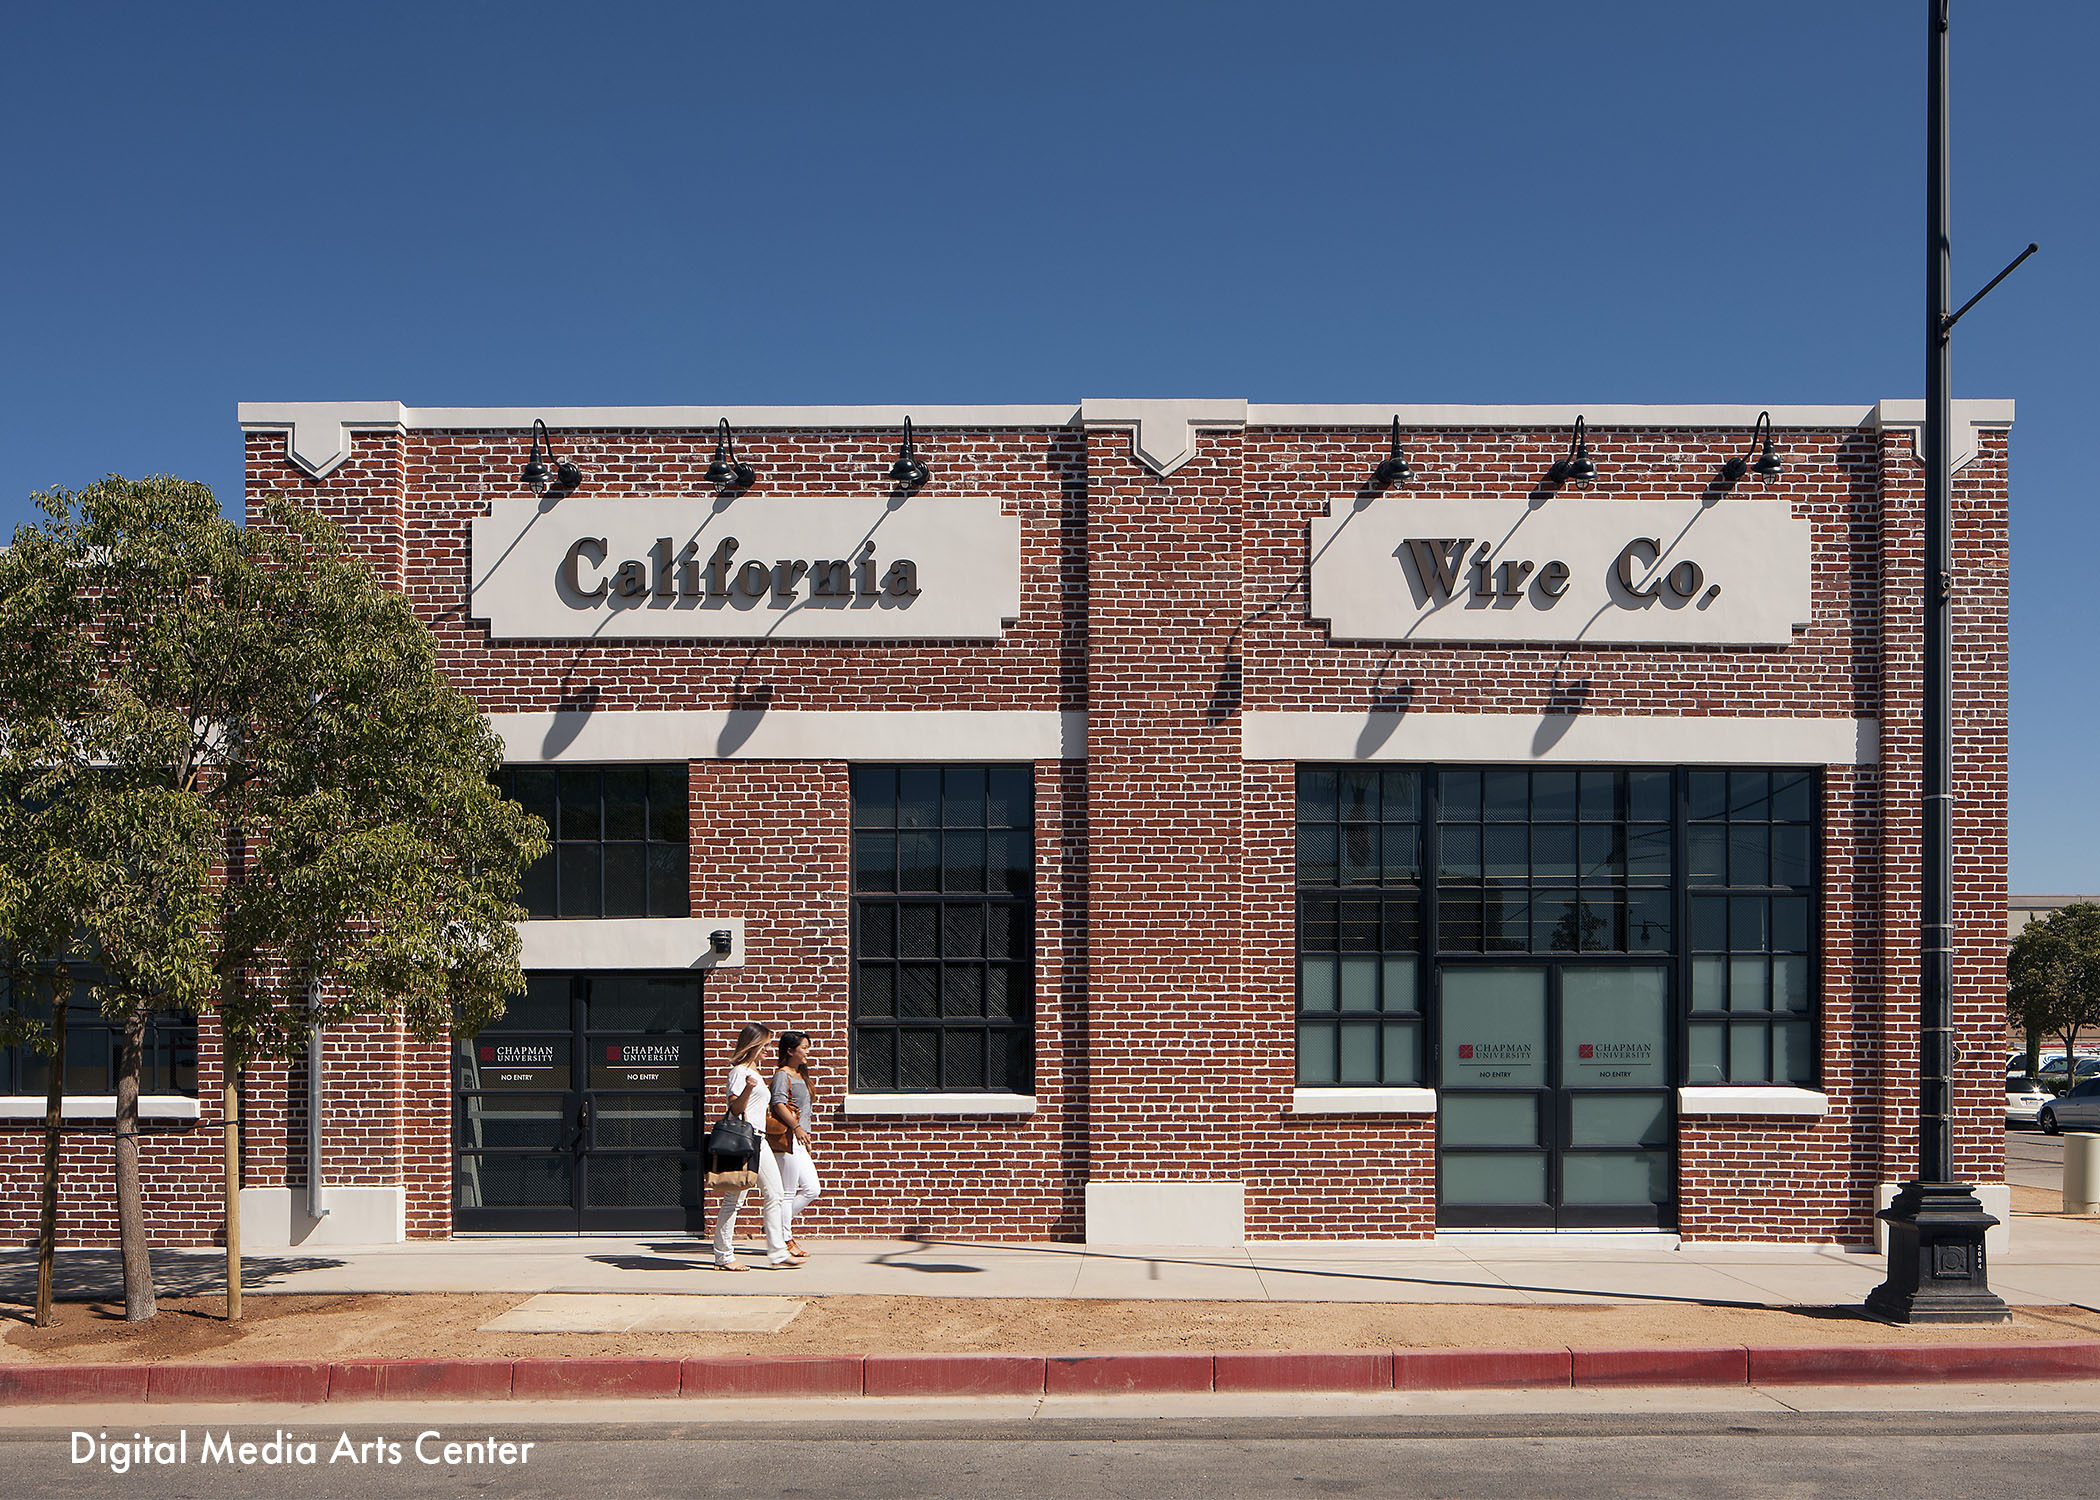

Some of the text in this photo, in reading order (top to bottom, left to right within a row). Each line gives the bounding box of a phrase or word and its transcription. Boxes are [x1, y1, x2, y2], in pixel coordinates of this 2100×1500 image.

[560, 537, 922, 601] California
[1400, 537, 1722, 600] Wire Co.
[497, 1046, 553, 1055] CHAPMAN
[623, 1046, 680, 1054] CHAPMAN
[1475, 1043, 1531, 1052] CHAPMAN
[1595, 1043, 1651, 1052] CHAPMAN
[497, 1054, 553, 1062] UNIVERSITY
[1476, 1051, 1532, 1059] UNIVERSITY
[1596, 1051, 1651, 1059] UNIVERSITY
